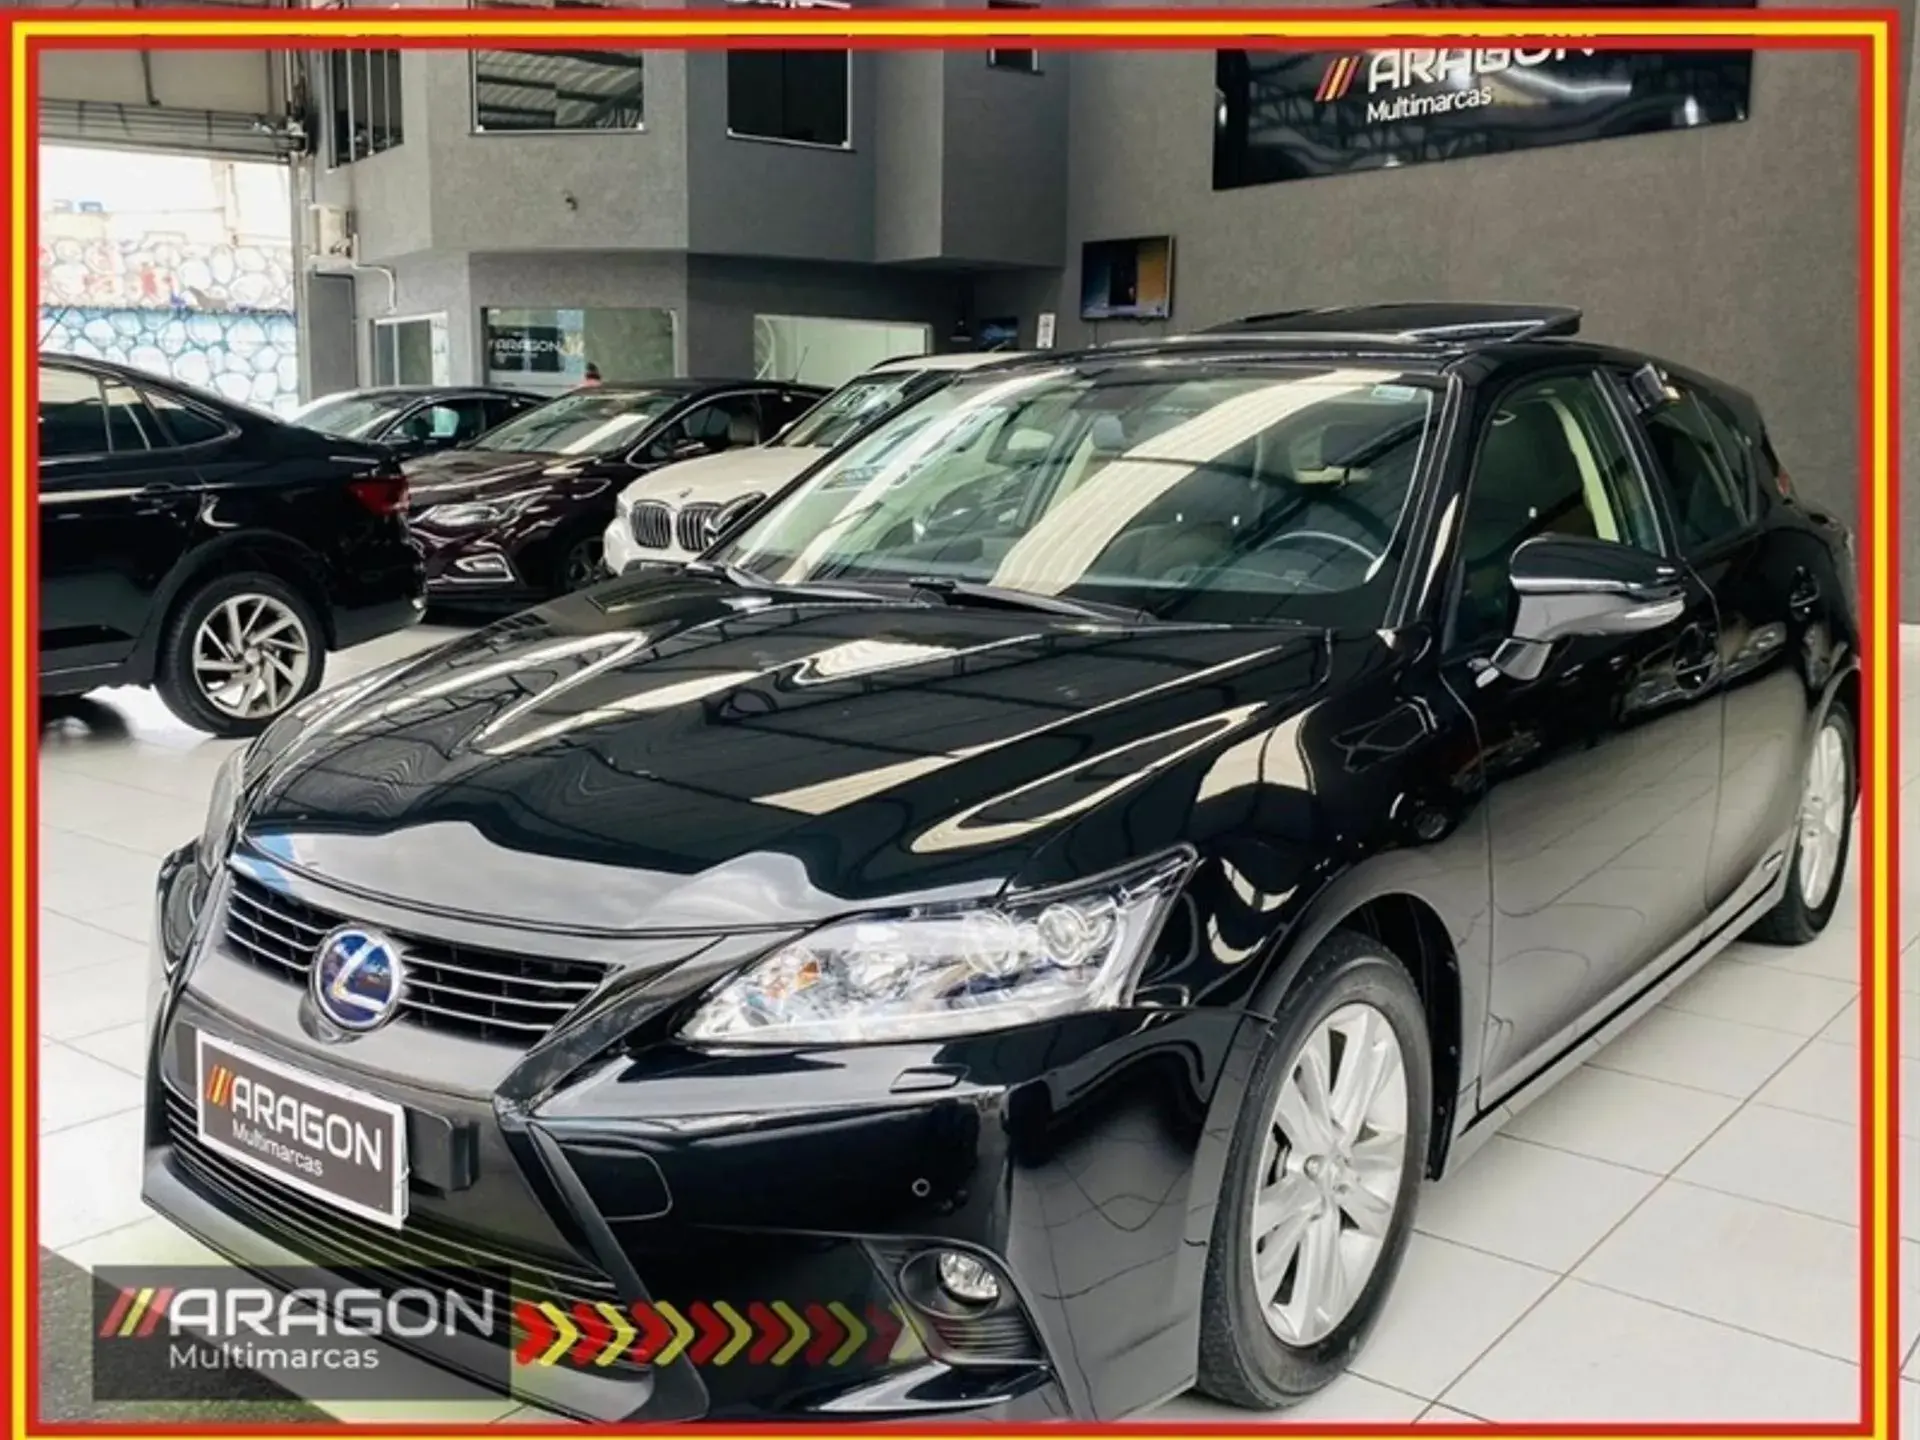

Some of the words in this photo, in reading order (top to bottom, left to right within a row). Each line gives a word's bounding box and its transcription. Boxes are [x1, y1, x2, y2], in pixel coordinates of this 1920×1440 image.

[1366, 86, 1492, 123] Multimarcas
[231, 1075, 382, 1172] ARAGON
[232, 1118, 324, 1177] Multimarcas
